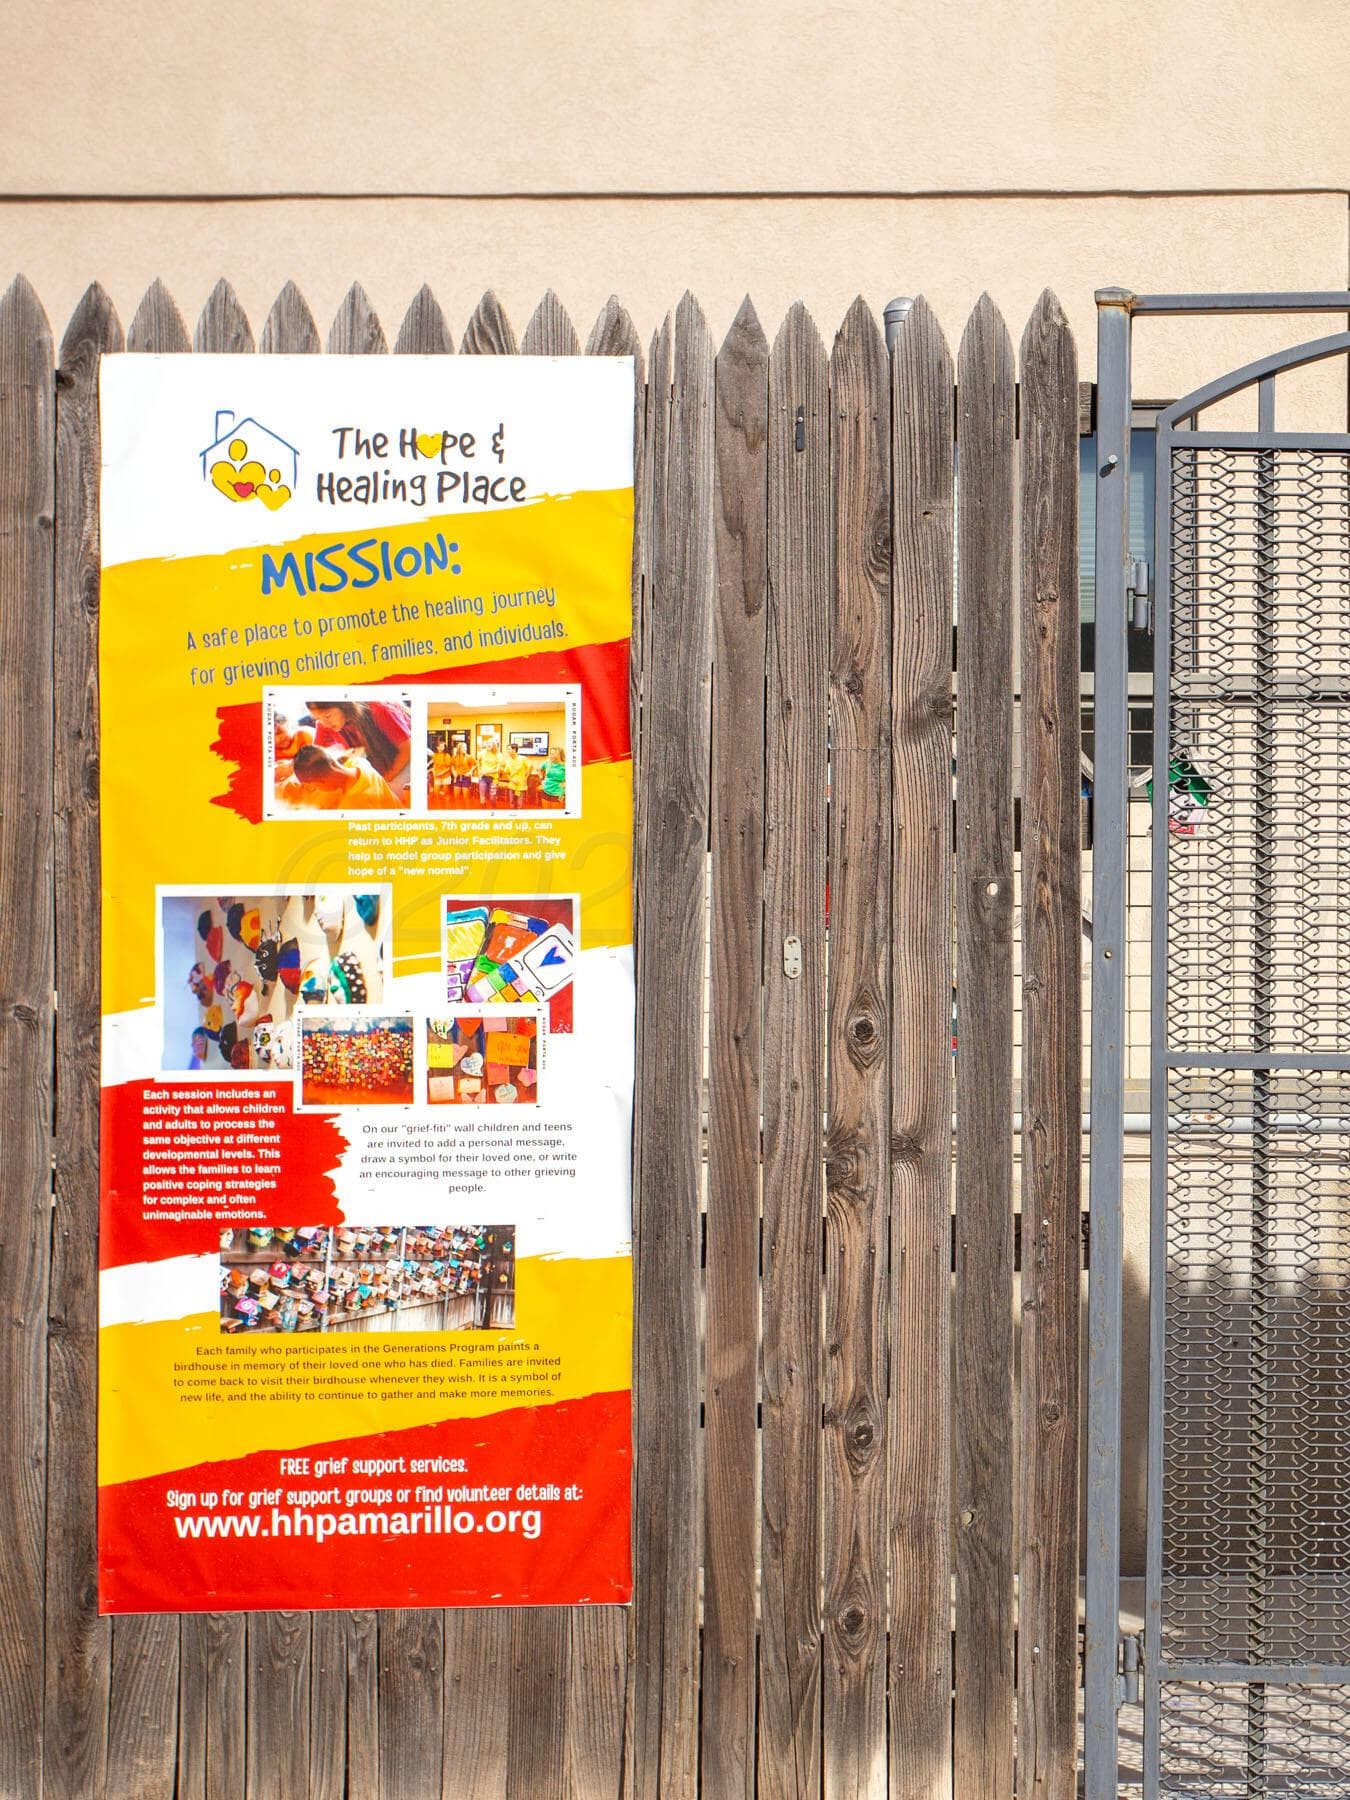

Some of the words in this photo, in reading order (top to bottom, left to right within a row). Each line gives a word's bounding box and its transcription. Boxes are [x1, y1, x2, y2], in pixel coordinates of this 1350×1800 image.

[331, 427, 389, 460] The
[491, 422, 505, 463] &
[316, 470, 427, 506] Healing
[437, 472, 527, 506] Place
[260, 532, 461, 596] MISSION:
[186, 631, 196, 650] A
[202, 627, 238, 647] safe
[244, 623, 287, 646] place
[293, 618, 313, 635] to
[317, 608, 387, 637] promote
[391, 603, 419, 622] the
[424, 595, 484, 618] healing
[491, 588, 556, 613] journey
[190, 667, 214, 685] for
[223, 658, 290, 685] grieving
[295, 650, 366, 671] children,
[371, 638, 438, 662] families,
[443, 631, 473, 651] and
[478, 620, 568, 647] individuals.
[142, 1090, 169, 1099] Each
[171, 1089, 213, 1098] session
[215, 1089, 260, 1098] includes
[142, 1105, 180, 1115] activity
[183, 1105, 204, 1113] that
[205, 1104, 240, 1113] allows
[242, 1104, 285, 1113] children
[142, 1120, 162, 1129] and
[164, 1120, 197, 1128] adults
[199, 1120, 211, 1128] to
[213, 1121, 255, 1130] process
[257, 1119, 275, 1128] the
[362, 1124, 378, 1133] On
[454, 1123, 474, 1132] wall
[477, 1123, 519, 1132] children
[521, 1122, 541, 1131] and
[544, 1123, 572, 1131] teens
[142, 1136, 171, 1144] same
[173, 1135, 221, 1145] objective
[223, 1135, 234, 1143] at
[235, 1134, 280, 1143] different
[386, 1139, 421, 1147] invited
[436, 1138, 456, 1147] add
[468, 1138, 513, 1149] personal
[515, 1139, 565, 1148] message,
[142, 1149, 219, 1160] developmental
[221, 1149, 255, 1158] levels.
[257, 1149, 280, 1158] This
[360, 1155, 386, 1163] draw
[398, 1154, 435, 1164] symbol
[438, 1154, 452, 1162] for
[455, 1153, 478, 1162] their
[482, 1152, 510, 1161] loved
[552, 1152, 577, 1160] write
[142, 1165, 176, 1174] allows
[178, 1164, 195, 1174] the
[197, 1164, 238, 1173] families
[241, 1165, 252, 1173] to
[254, 1164, 280, 1173] learn
[375, 1170, 439, 1179] encouraging
[442, 1170, 488, 1179] message
[504, 1168, 531, 1176] other
[534, 1168, 576, 1178] grieving
[142, 1180, 184, 1191] positive
[186, 1180, 222, 1190] coping
[224, 1179, 276, 1190] strategies
[448, 1183, 486, 1194] people.
[142, 1195, 157, 1204] for
[159, 1195, 204, 1206] complex
[206, 1194, 227, 1204] and
[228, 1194, 256, 1203] often
[142, 1210, 212, 1221] unimaginable
[214, 1208, 266, 1218] emotions.
[195, 1346, 223, 1355] Each
[225, 1345, 257, 1356] family
[259, 1345, 282, 1354] who
[285, 1345, 347, 1356] participates
[350, 1344, 360, 1352] in
[363, 1344, 380, 1353] the
[382, 1344, 446, 1353] Generations
[449, 1343, 495, 1353] Program
[497, 1343, 530, 1353] paints
[173, 1362, 227, 1371] birdhouse
[230, 1362, 240, 1370] in
[243, 1363, 286, 1371] memory
[288, 1360, 300, 1369] of
[302, 1360, 325, 1369] their
[329, 1360, 359, 1369] loved
[384, 1359, 406, 1368] who
[408, 1359, 428, 1367] has
[430, 1359, 456, 1367] died.
[459, 1357, 503, 1367] Families
[526, 1356, 561, 1365] invited
[219, 1376, 244, 1385] back
[260, 1376, 283, 1385] visit
[285, 1376, 309, 1384] their
[312, 1375, 366, 1384] birdhouse
[369, 1375, 419, 1383] whenever
[422, 1374, 445, 1385] they
[447, 1373, 475, 1382] wish.
[478, 1374, 485, 1382] It
[510, 1372, 548, 1383] symbol
[551, 1372, 561, 1380] of
[205, 1392, 224, 1401] life,
[227, 1392, 247, 1401] and
[249, 1392, 266, 1400] the
[269, 1391, 301, 1402] ability
[304, 1392, 315, 1400] to
[367, 1391, 377, 1399] to
[380, 1389, 413, 1401] gather
[416, 1389, 436, 1398] and
[439, 1389, 467, 1398] make
[280, 1458, 309, 1474] FREE
[314, 1458, 348, 1476] grief
[352, 1457, 406, 1475] support
[410, 1457, 467, 1472] services.
[166, 1490, 196, 1508] Sign
[200, 1492, 217, 1508] up
[222, 1489, 243, 1505] for
[248, 1488, 282, 1507] grief
[286, 1487, 341, 1507] support
[345, 1489, 392, 1506] groups
[396, 1489, 410, 1502] or
[415, 1486, 442, 1502] find
[446, 1485, 511, 1501] volunteer
[515, 1484, 560, 1500] details
[563, 1484, 582, 1500] at:
[174, 1505, 542, 1542] www.hhpamarillo.org
